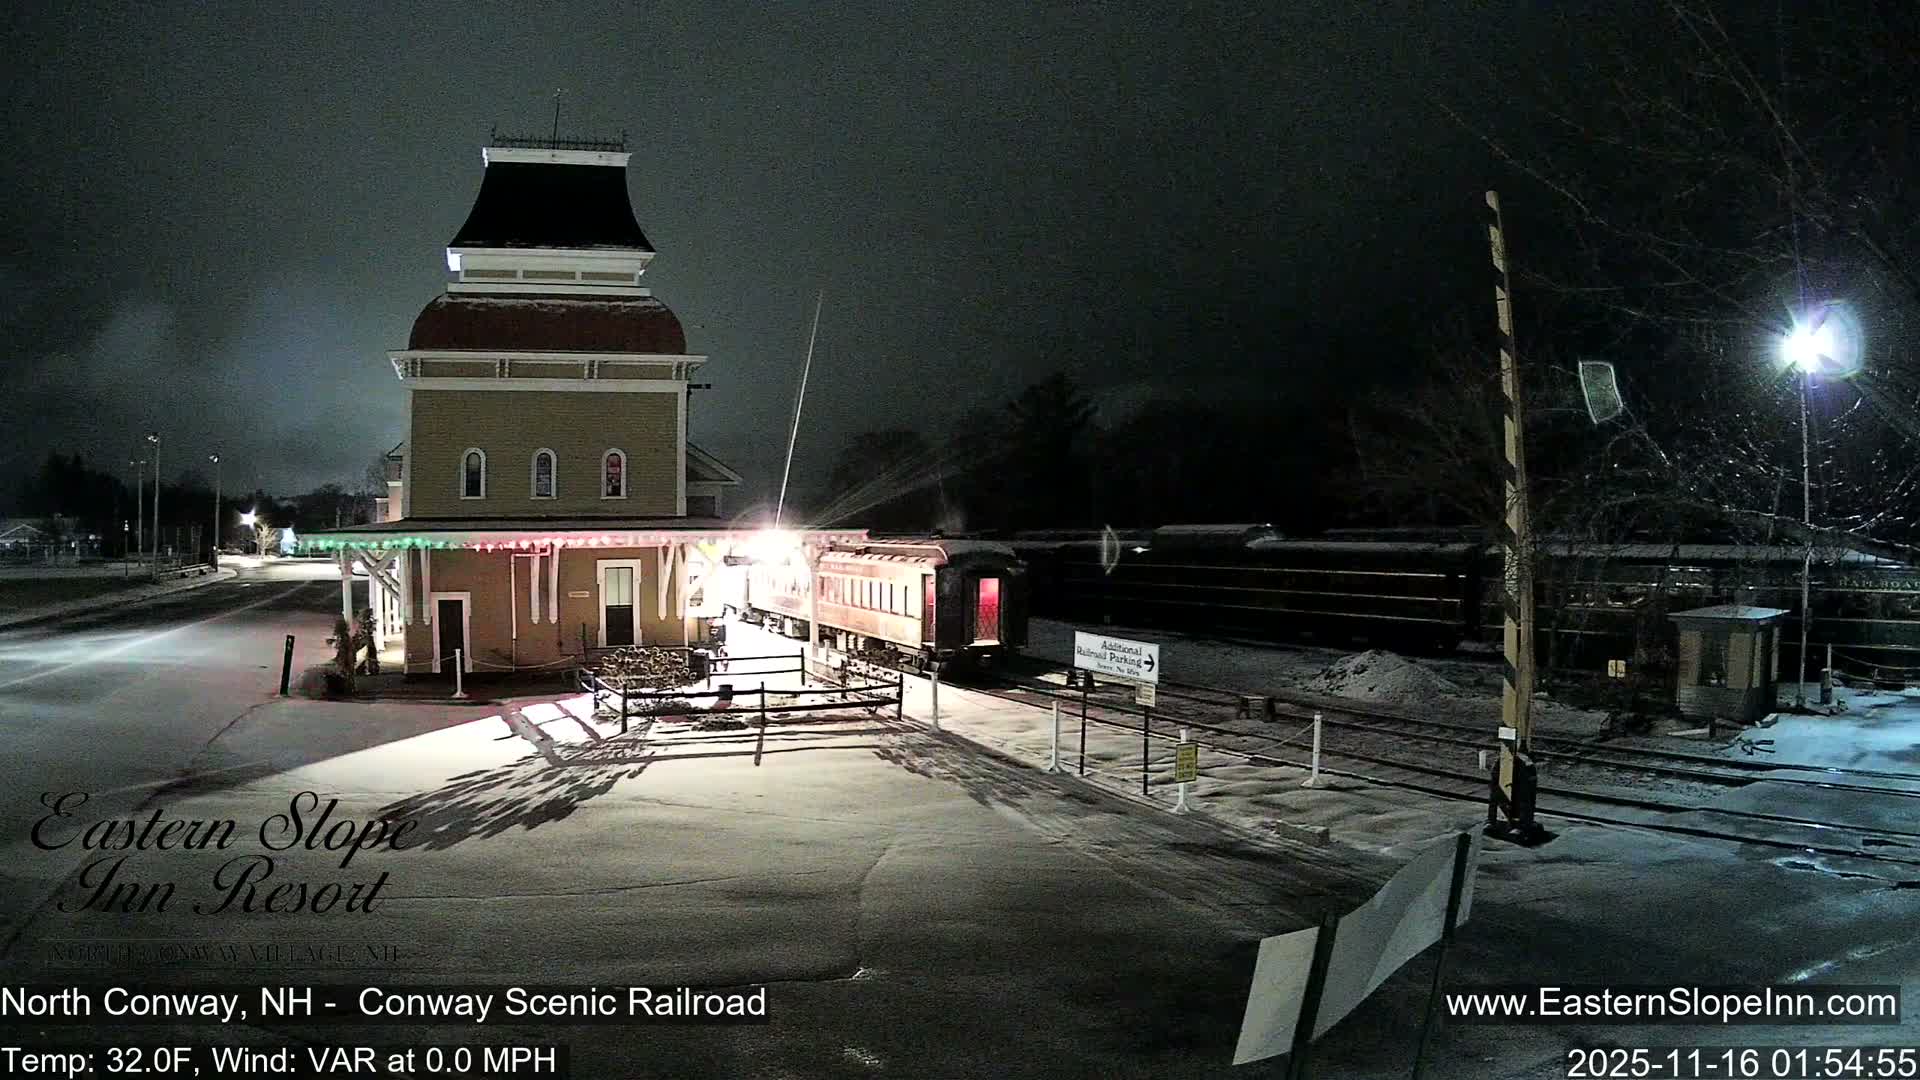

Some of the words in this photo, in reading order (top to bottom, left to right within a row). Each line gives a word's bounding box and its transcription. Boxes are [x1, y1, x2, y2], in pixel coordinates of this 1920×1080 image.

[1076, 646, 1107, 660] Railroad
[1109, 652, 1142, 668] Parking
[1101, 640, 1142, 656] Additional
